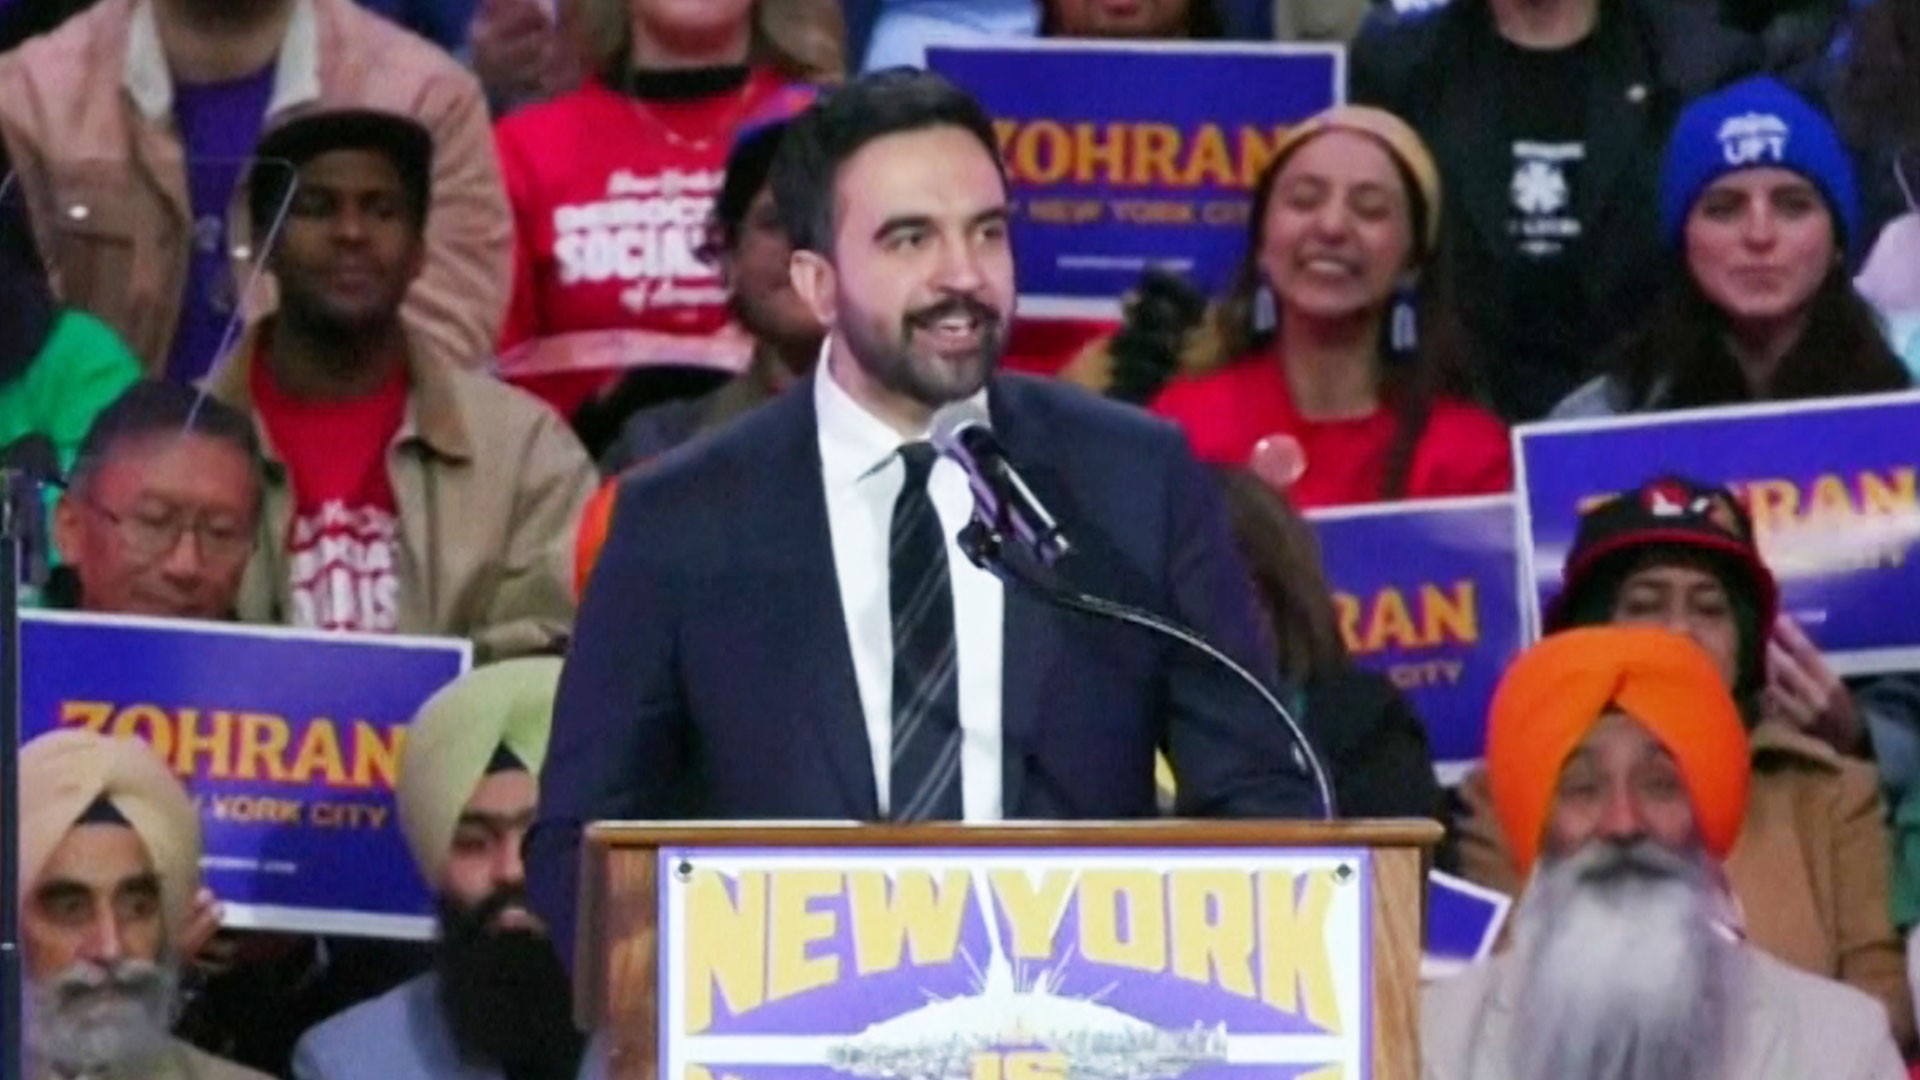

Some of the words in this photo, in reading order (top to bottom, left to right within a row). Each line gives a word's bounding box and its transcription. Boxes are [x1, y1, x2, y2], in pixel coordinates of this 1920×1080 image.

[211, 794, 301, 822] YORK
[312, 803, 388, 829] CITY
[685, 869, 972, 1036] NEW
[987, 868, 1345, 1036] YORK
